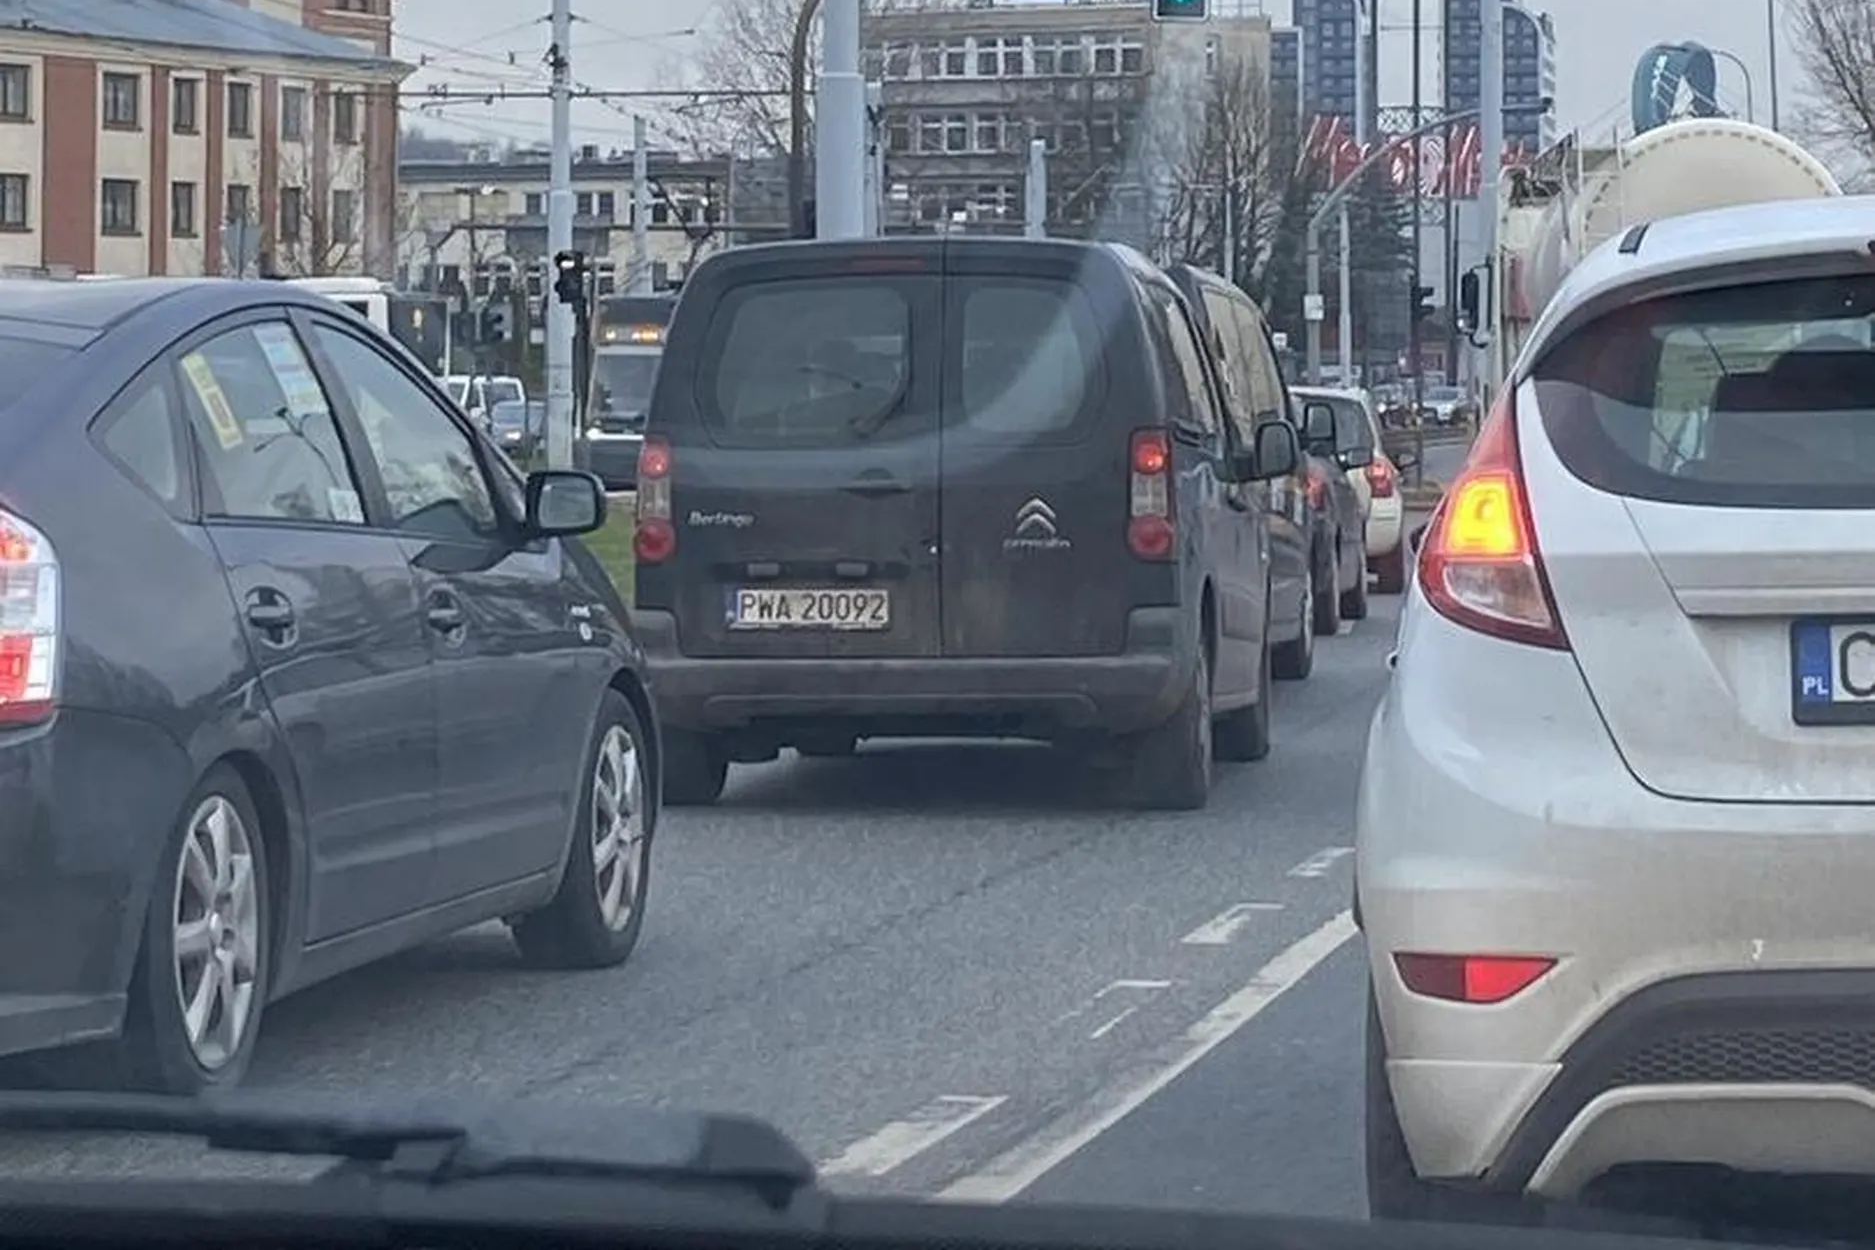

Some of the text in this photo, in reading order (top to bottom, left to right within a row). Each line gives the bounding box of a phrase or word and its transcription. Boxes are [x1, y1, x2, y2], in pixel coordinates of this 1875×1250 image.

[740, 593, 792, 620] PWA
[801, 593, 886, 621] 20092
[1802, 675, 1829, 695] PL
